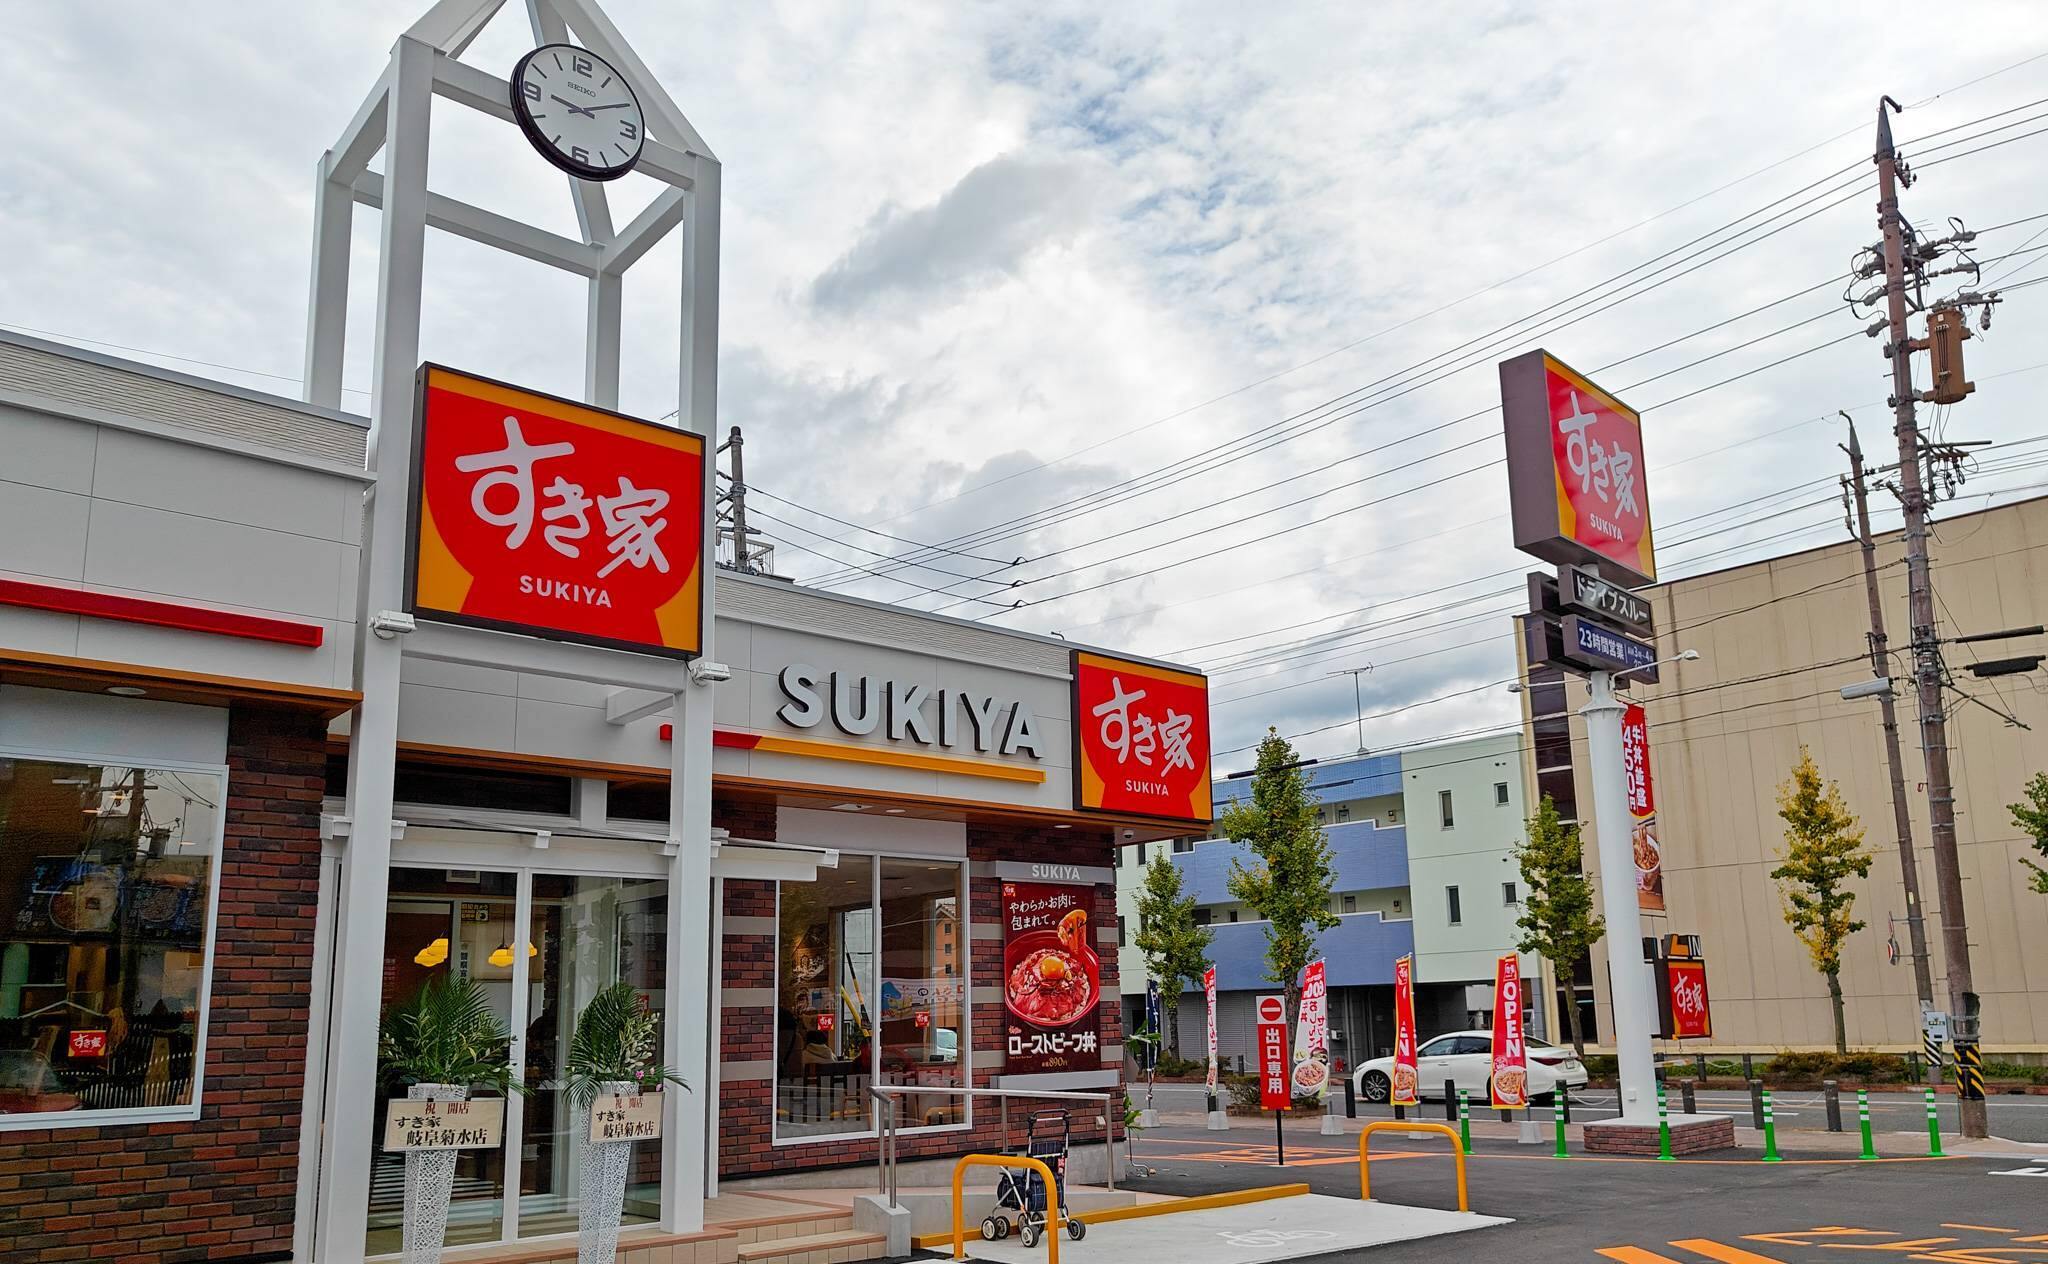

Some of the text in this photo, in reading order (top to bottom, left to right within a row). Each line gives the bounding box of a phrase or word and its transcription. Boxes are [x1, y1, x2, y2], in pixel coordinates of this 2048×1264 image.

[572, 55, 593, 79] 12
[523, 81, 542, 102] 9
[567, 81, 597, 98] SEIKO
[619, 119, 637, 140] 3
[571, 145, 589, 165] 6
[1558, 388, 1639, 520] すき家
[455, 415, 670, 578] すき家
[1589, 512, 1624, 543] SUKIYA
[519, 575, 613, 608] SUKIYA
[1576, 575, 1648, 621] ドライブスルー
[1578, 627, 1625, 661] 23時間営業
[776, 663, 1044, 759] SUKIYA
[1092, 676, 1195, 778] すき家
[1623, 725, 1637, 811] 450円
[1632, 725, 1647, 808] 牛丼並盛
[1125, 779, 1169, 796] SUKIYA
[1032, 864, 1080, 880] SUKIYA
[1009, 893, 1077, 914] やわらかお肉に
[1010, 913, 1056, 931] 包まれて。
[1688, 934, 1702, 956] IN
[1674, 971, 1704, 1018] すき家
[1503, 982, 1521, 1057] OPEN
[1008, 1031, 1097, 1055] ローストビーフ丼
[1265, 1028, 1283, 1094] 出口専用
[425, 1102, 471, 1115] 祝 開店
[595, 1110, 626, 1122] すき家
[394, 1115, 442, 1128] すき家
[603, 1120, 654, 1138] 岐阜菊水店
[406, 1129, 488, 1147] 岐阜菊水店
